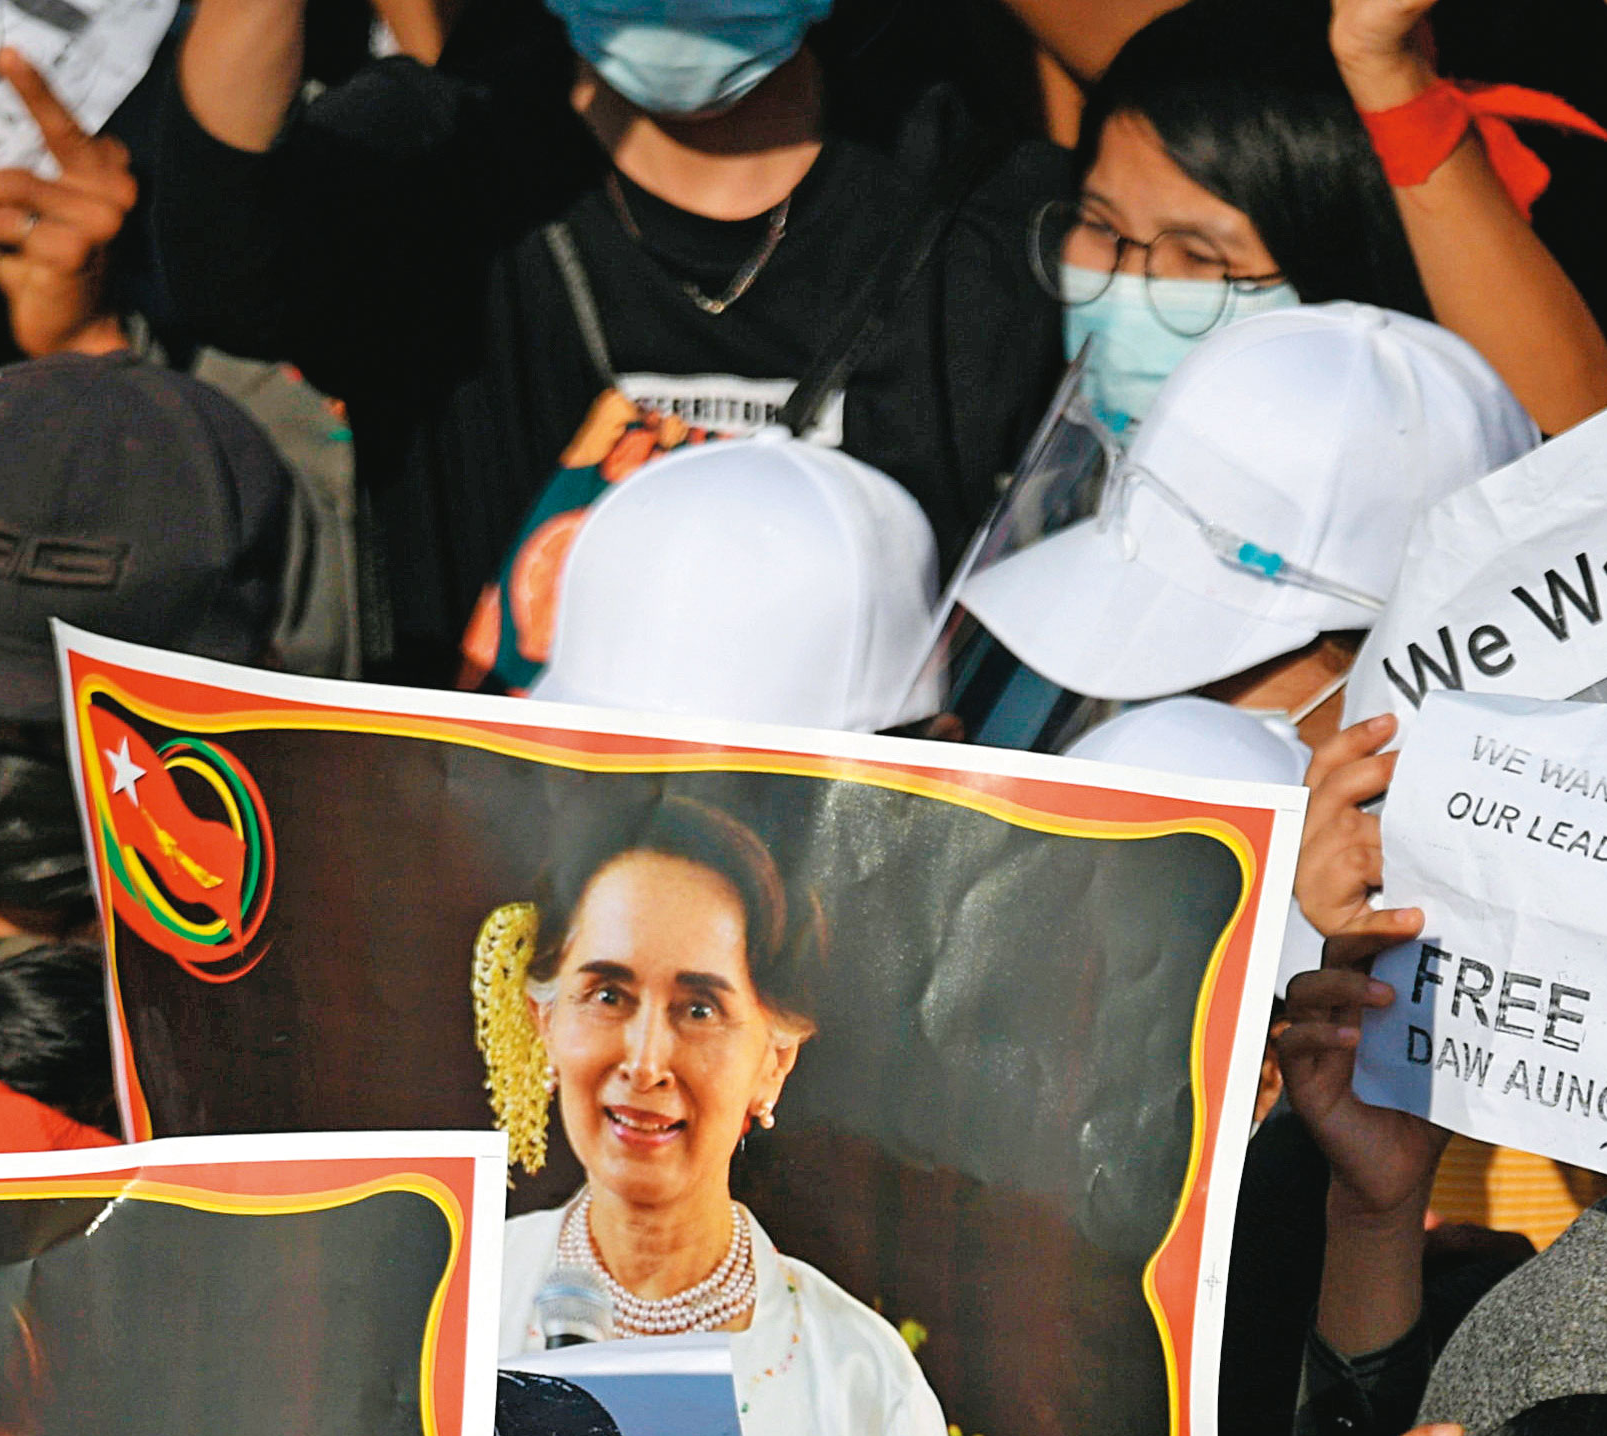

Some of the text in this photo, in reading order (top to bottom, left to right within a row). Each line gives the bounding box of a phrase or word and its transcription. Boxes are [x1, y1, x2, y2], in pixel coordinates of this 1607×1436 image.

[1472, 735, 1531, 775] WE
[1446, 791, 1520, 838] OUR
[1411, 942, 1592, 1053] FREE
[1407, 1024, 1493, 1088] DAW
